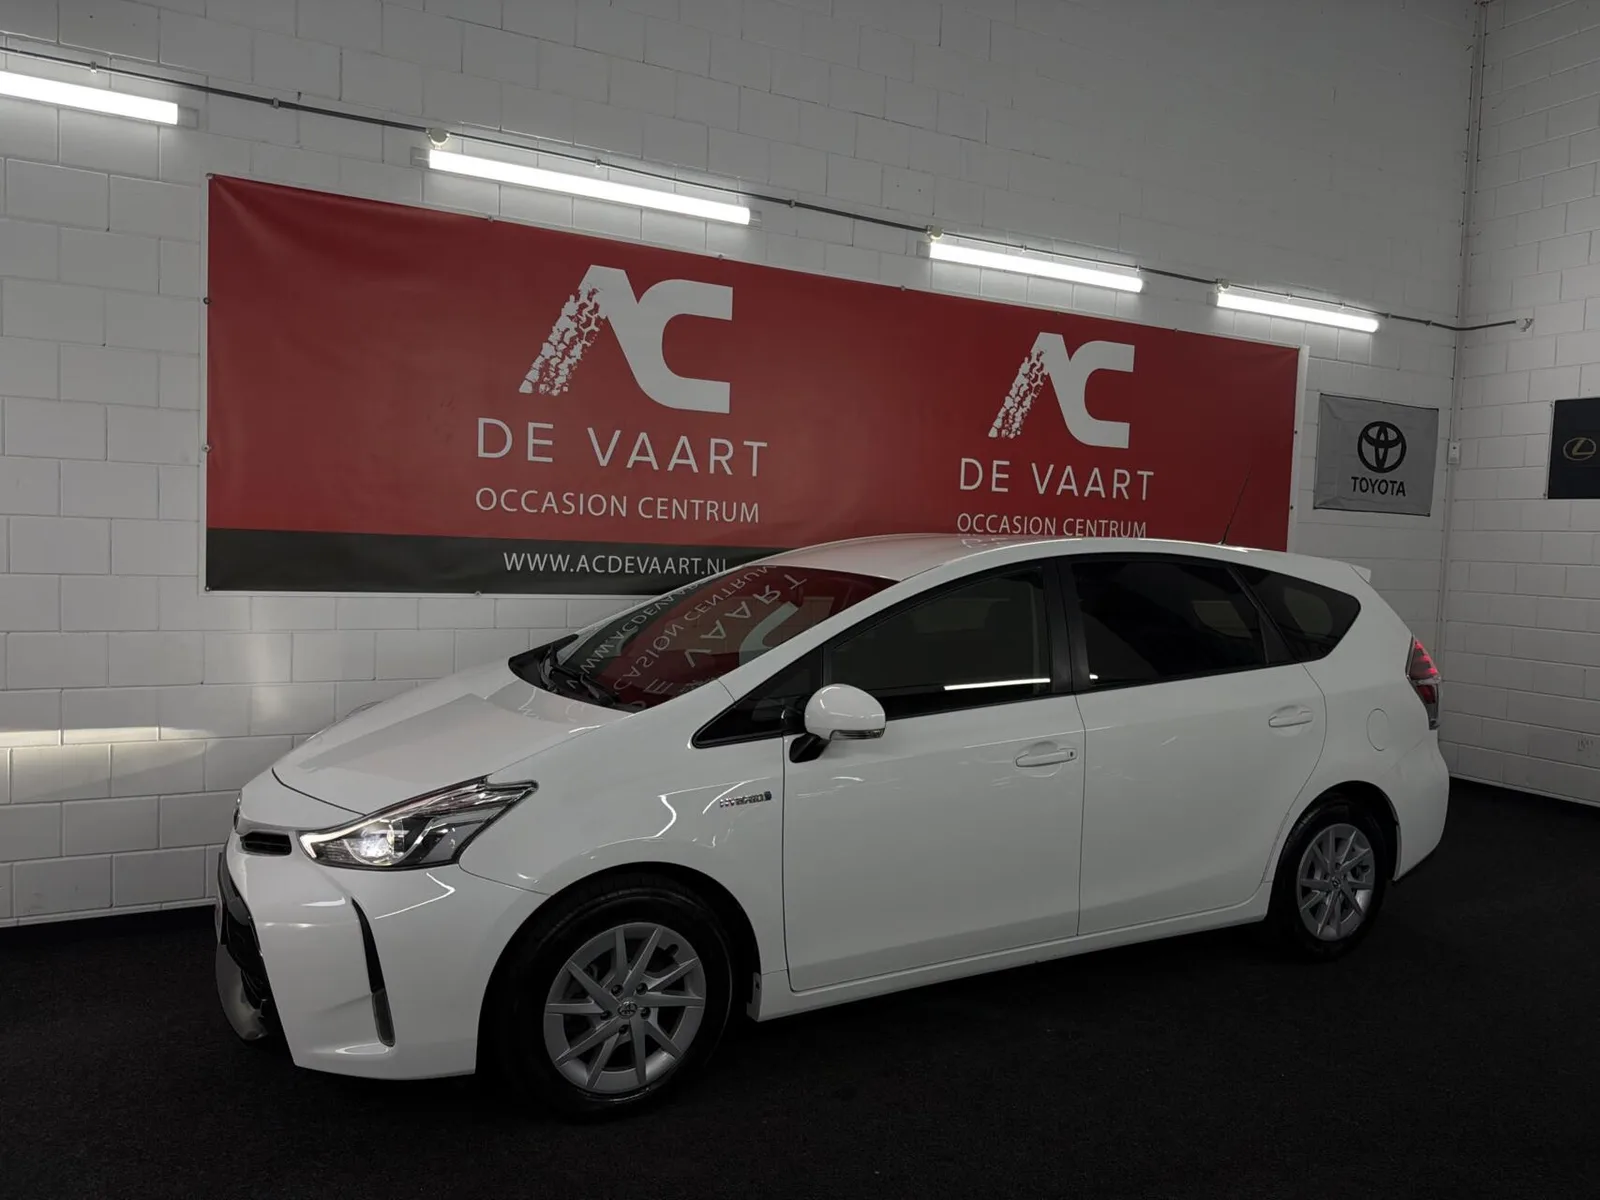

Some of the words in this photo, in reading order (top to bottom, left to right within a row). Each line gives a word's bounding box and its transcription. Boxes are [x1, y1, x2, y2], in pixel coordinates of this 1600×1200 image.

[477, 418, 554, 463] DE
[587, 427, 768, 477] VAART
[959, 457, 1011, 493] DE
[1031, 462, 1154, 501] VAART
[1351, 476, 1406, 497] TOYOTA
[476, 487, 627, 517] OCCASION
[638, 496, 760, 523] CENTRUM
[956, 512, 1056, 536] OCCASION
[1063, 517, 1147, 539] CENTRUM
